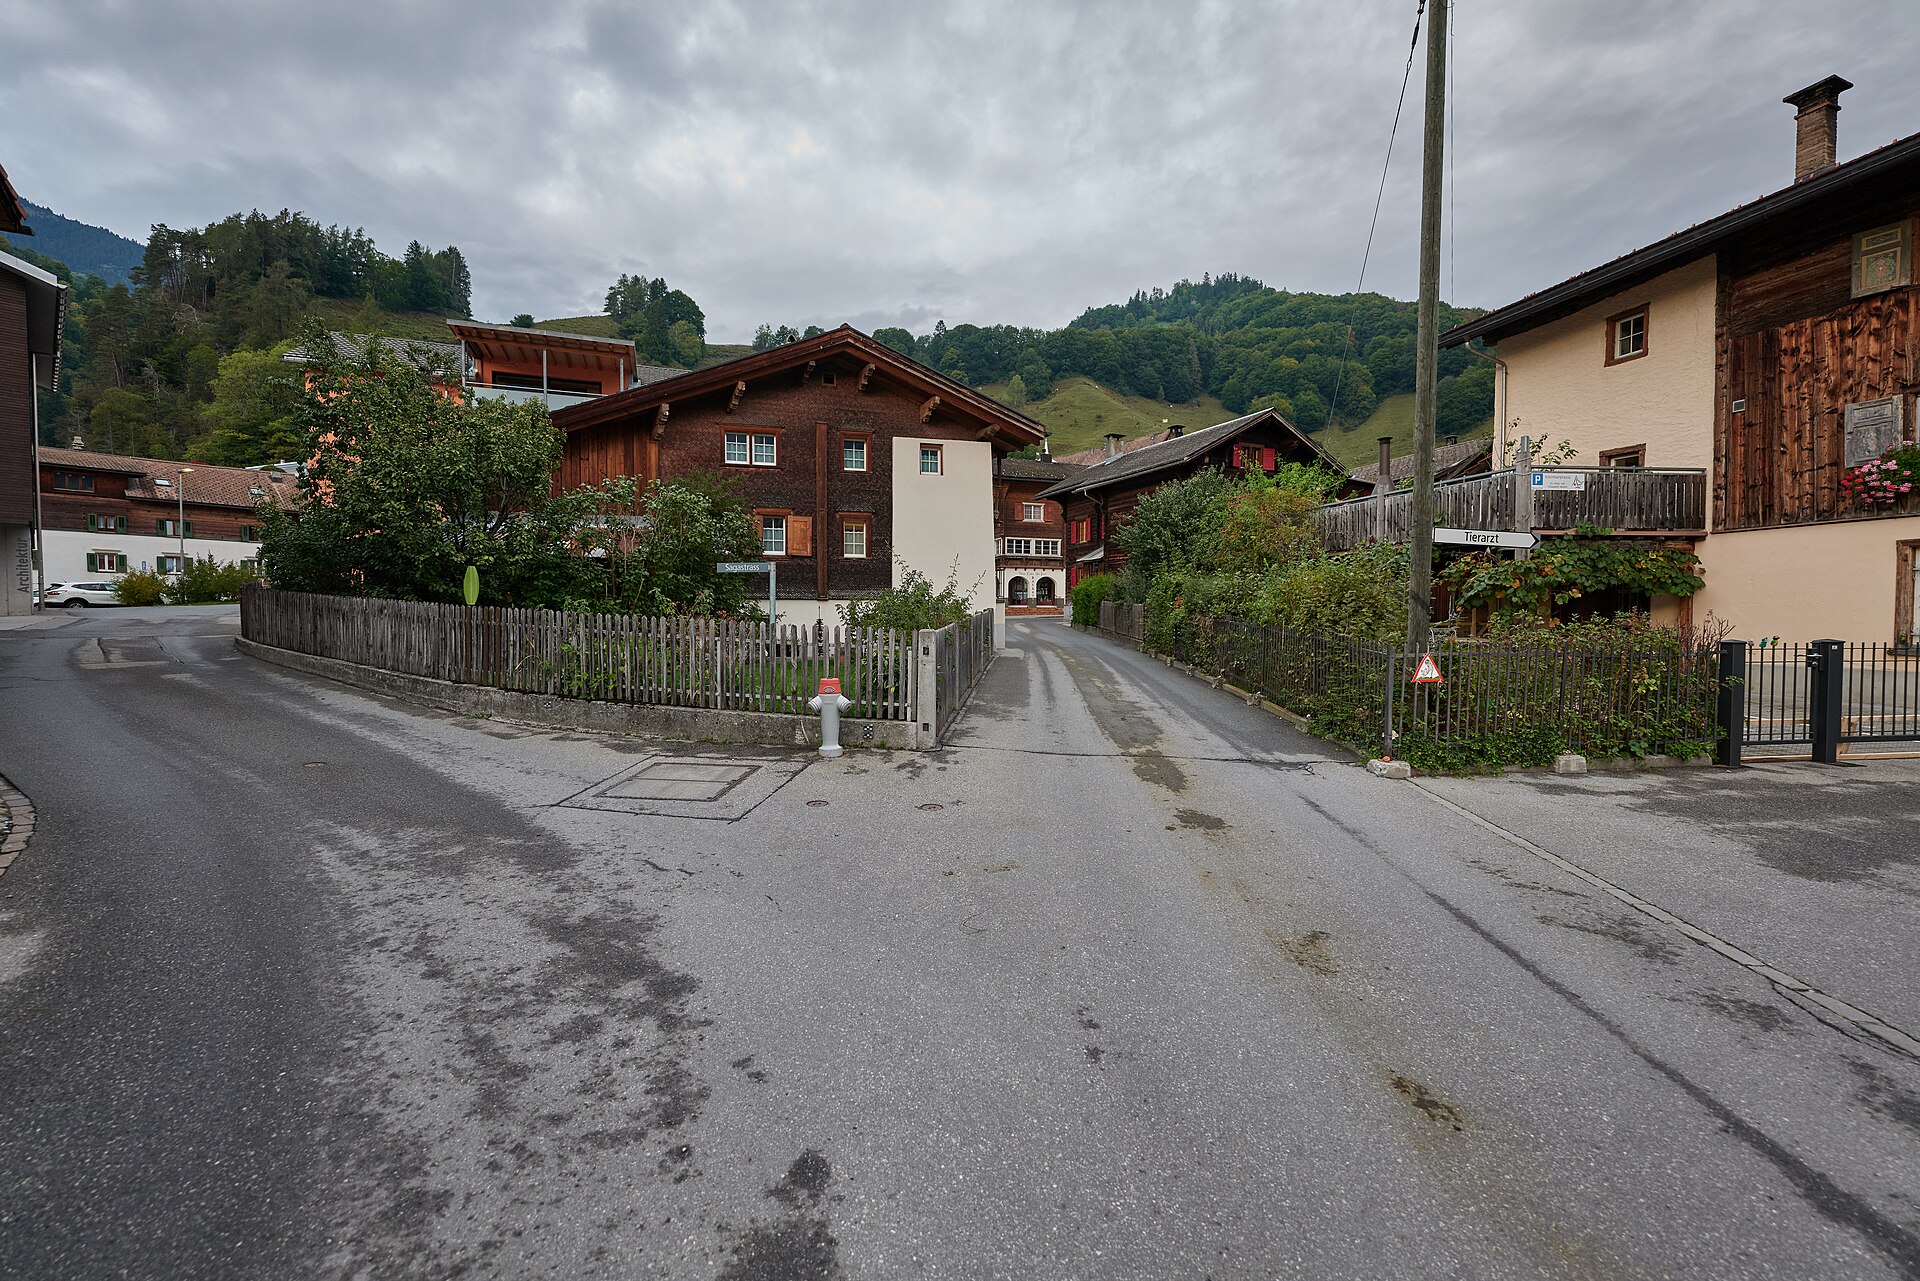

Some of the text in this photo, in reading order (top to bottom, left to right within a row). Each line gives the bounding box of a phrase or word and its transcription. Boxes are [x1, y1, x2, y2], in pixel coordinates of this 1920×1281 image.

[1464, 531, 1500, 544] Tierarzt
[16, 537, 30, 594] Architektur
[725, 563, 760, 573] Sagastrass
